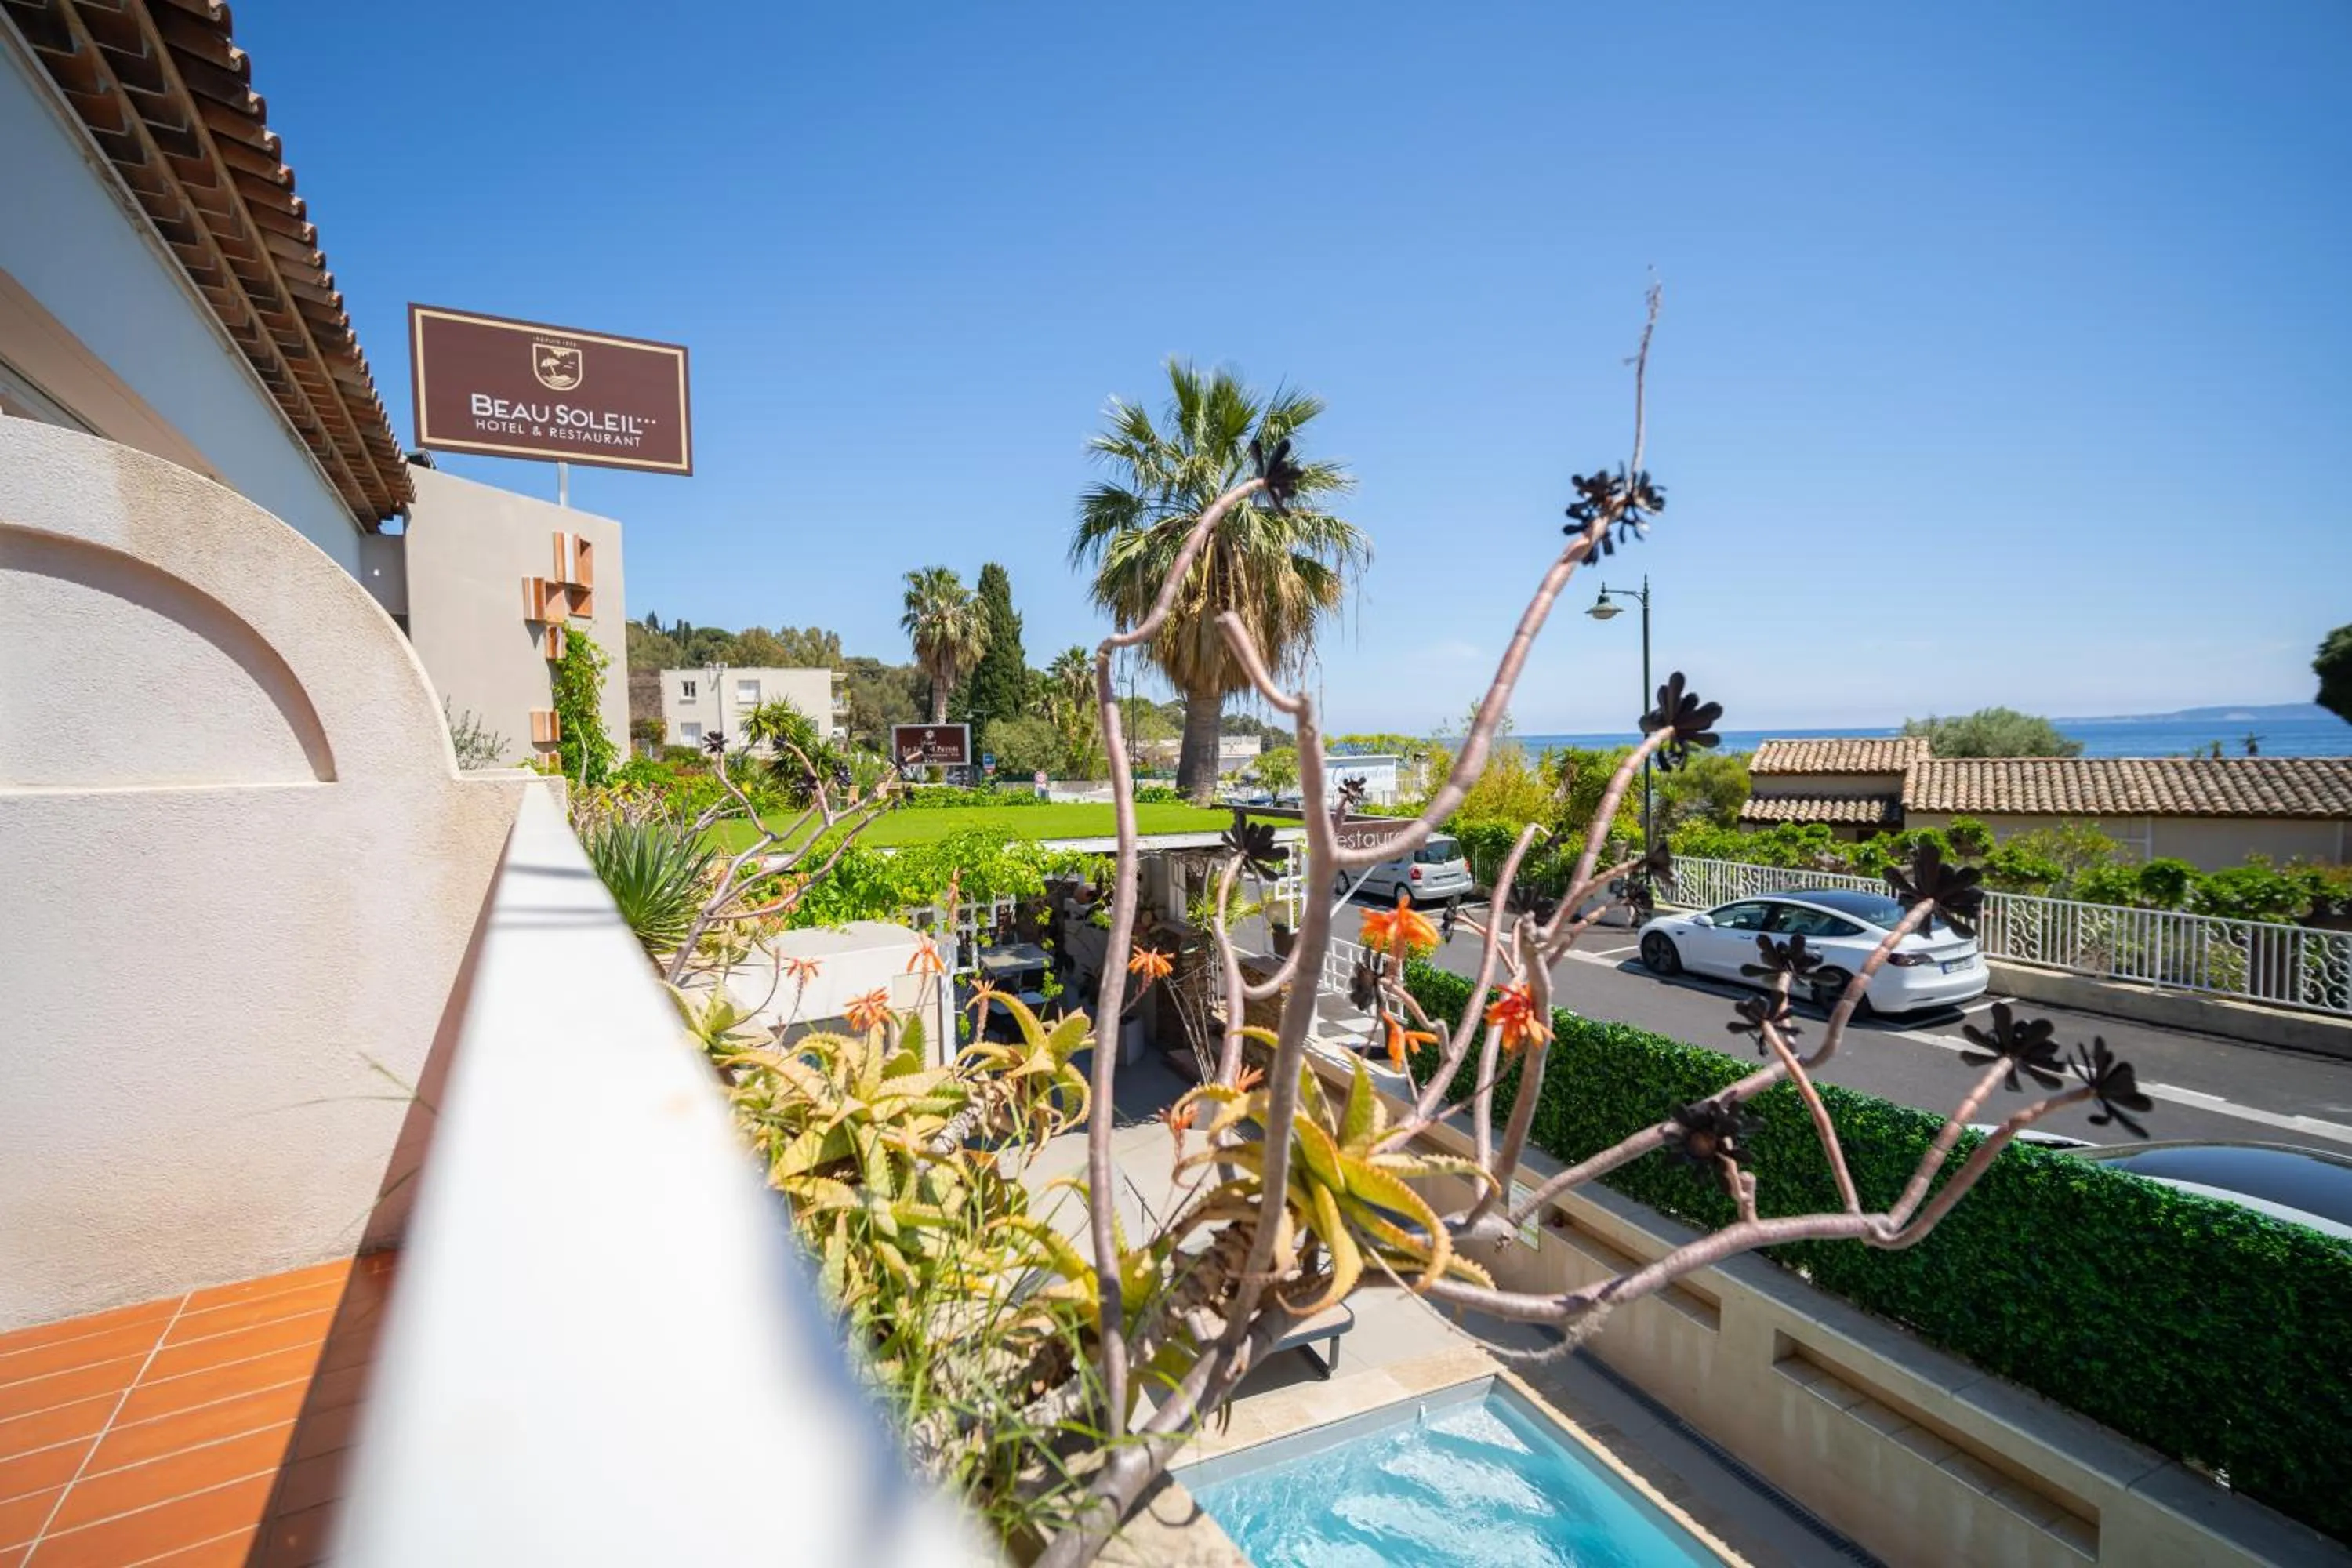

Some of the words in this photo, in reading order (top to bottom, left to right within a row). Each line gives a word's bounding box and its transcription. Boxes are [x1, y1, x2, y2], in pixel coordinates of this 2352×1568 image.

[471, 393, 550, 423] BEAU
[555, 404, 644, 435] SOLEIL
[476, 419, 525, 435] HOTEL
[532, 426, 543, 437] &
[550, 426, 641, 448] RESTAURANT
